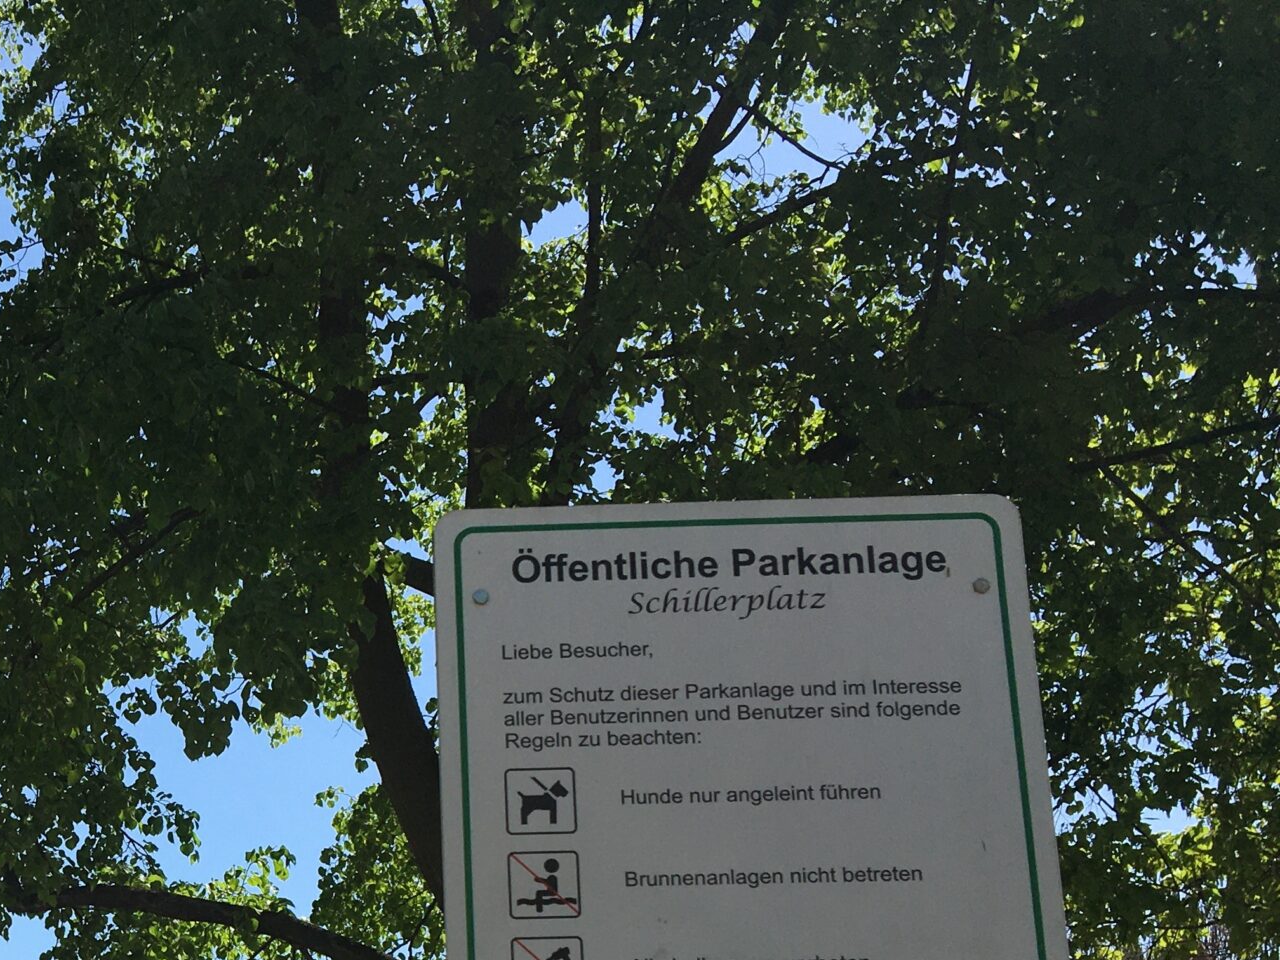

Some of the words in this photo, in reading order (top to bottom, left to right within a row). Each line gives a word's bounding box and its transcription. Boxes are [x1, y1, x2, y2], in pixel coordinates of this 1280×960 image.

[512, 548, 718, 583] Öffentliche
[732, 545, 946, 580] Parkanlage
[628, 585, 826, 620] Schillerplatz
[502, 644, 553, 660] Liebe
[560, 641, 653, 658] Besucher,
[503, 692, 543, 704] zum
[549, 687, 615, 703] Schutz
[620, 685, 679, 701] dieser
[685, 682, 794, 701] Parkanlage
[801, 680, 836, 696] und
[843, 680, 866, 695] im
[872, 679, 962, 695] Interesse
[504, 710, 544, 726] aller
[550, 708, 688, 725] Benutzerinnen
[695, 705, 730, 721] und
[737, 704, 824, 720] Benutzer
[830, 702, 870, 718] sind
[876, 700, 960, 720] folgende
[505, 732, 572, 752] Regeln
[578, 735, 600, 747] zu
[607, 729, 701, 746] beachten:
[621, 788, 683, 805] Hunde
[690, 791, 721, 803] nur
[726, 785, 815, 806] angeleint
[819, 784, 881, 800] führen
[625, 869, 783, 888] Brunnenanlagen
[790, 867, 837, 883] nicht
[842, 867, 923, 882] betreten
